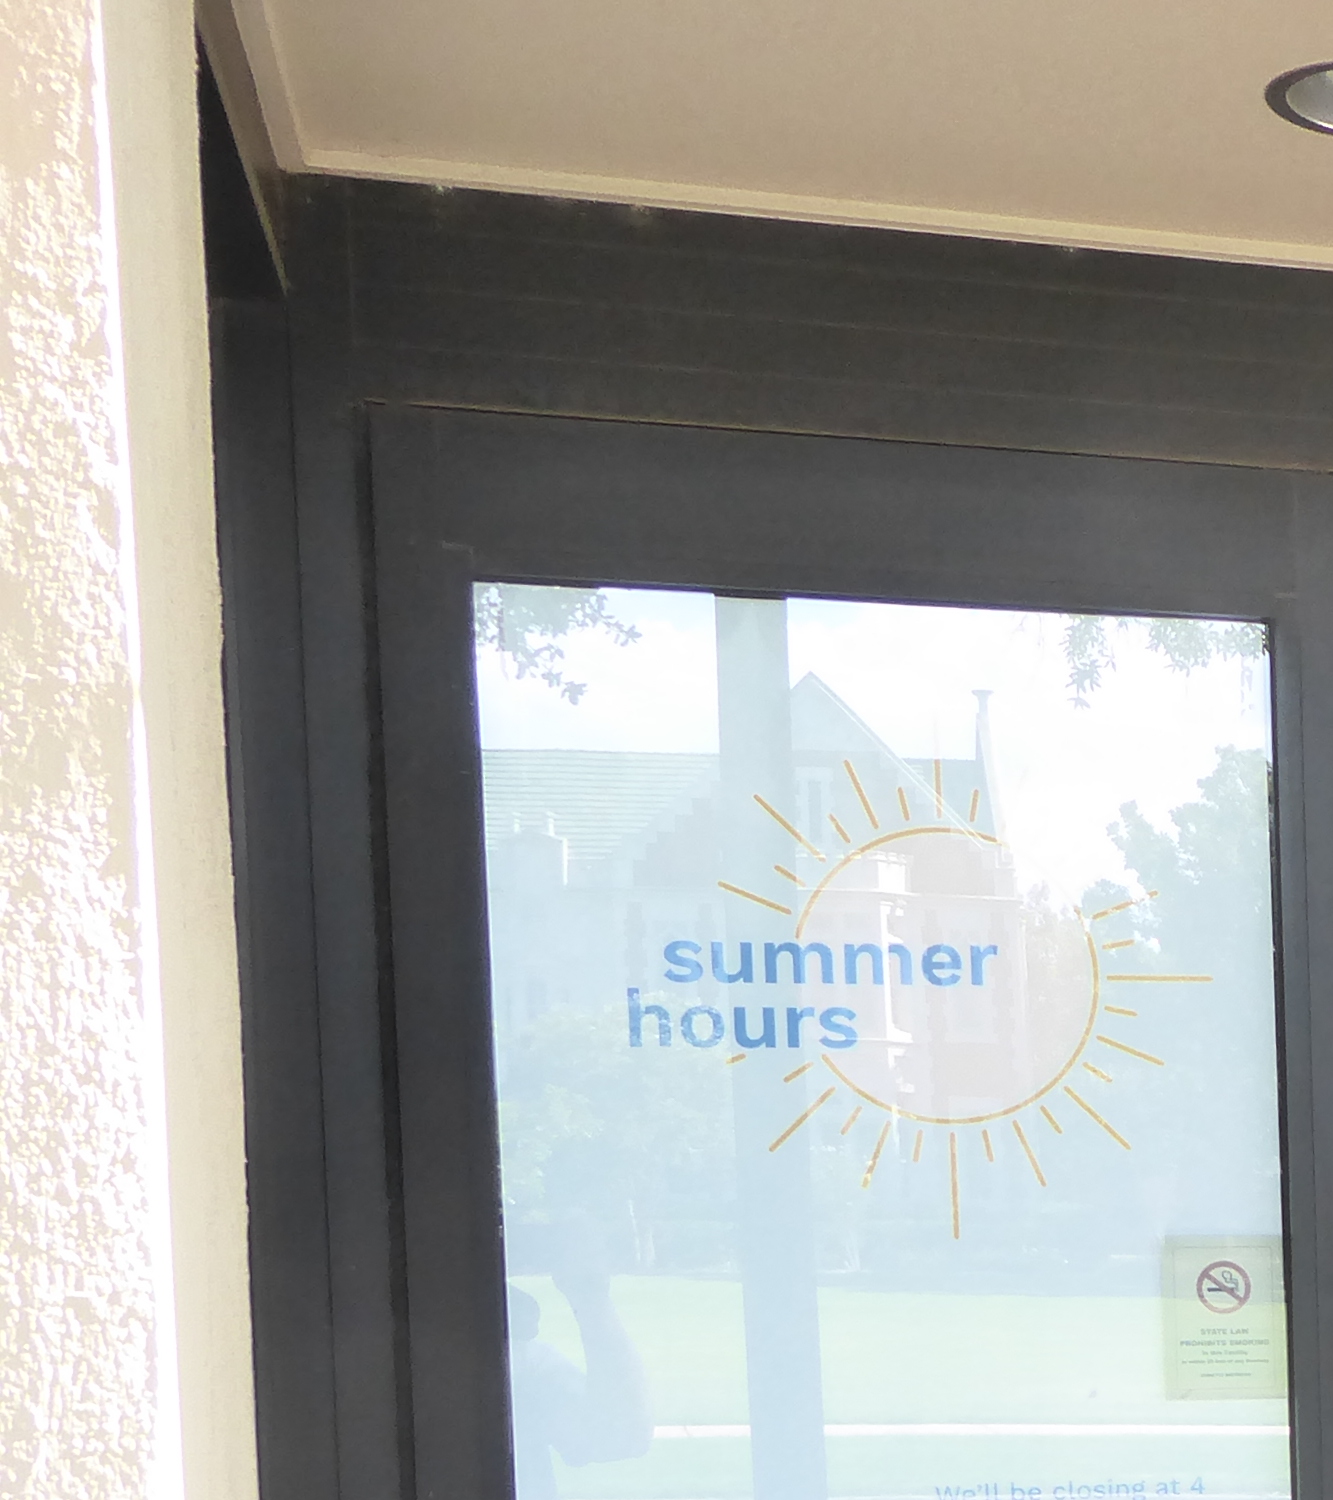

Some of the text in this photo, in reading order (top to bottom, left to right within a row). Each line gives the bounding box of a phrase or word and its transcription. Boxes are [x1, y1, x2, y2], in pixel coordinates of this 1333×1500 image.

[662, 937, 998, 987] summer
[627, 988, 858, 1050] hours
[1156, 1479, 1180, 1495] at
[1190, 1476, 1205, 1495] 4
